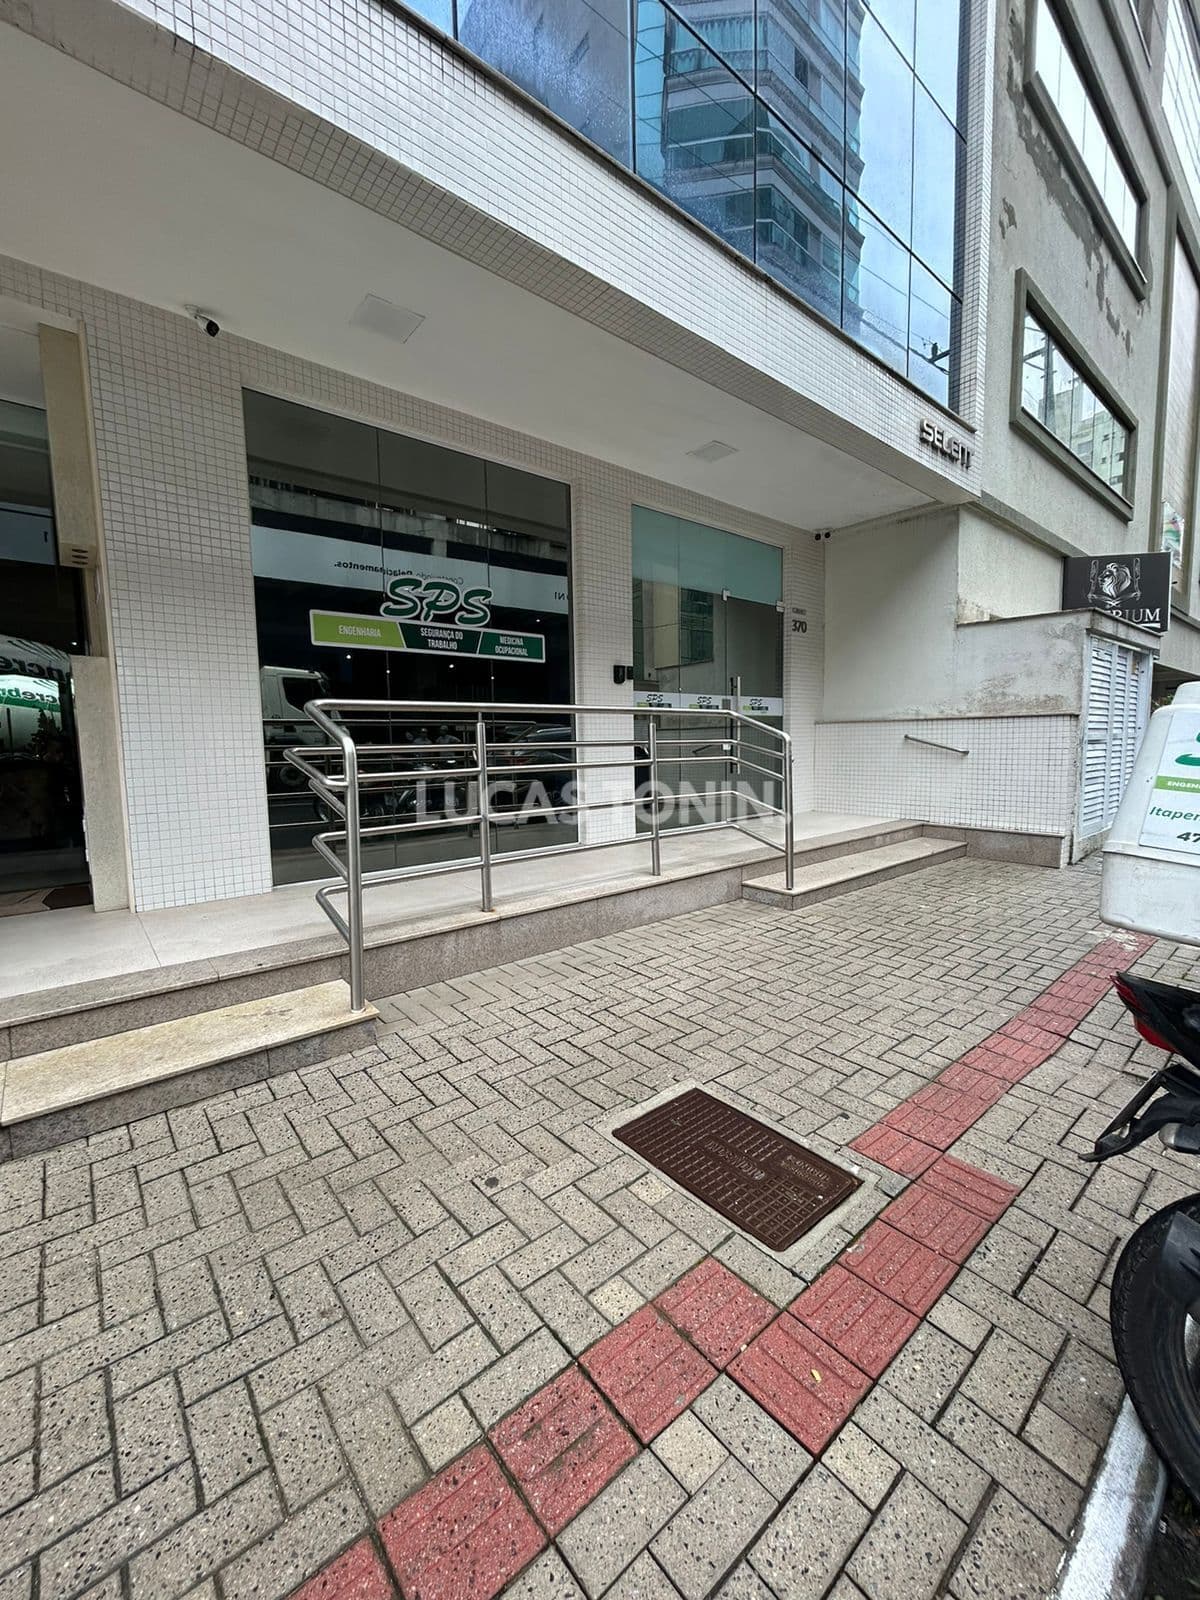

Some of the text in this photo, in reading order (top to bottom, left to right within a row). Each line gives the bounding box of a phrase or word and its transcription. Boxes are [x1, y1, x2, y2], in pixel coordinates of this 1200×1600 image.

[380, 577, 493, 626] SPS
[338, 625, 382, 637] ENGENHARIA
[791, 619, 807, 633] 370
[420, 627, 464, 640] SEGURANÇA DO
[427, 639, 458, 650] TRABALHO
[500, 636, 524, 646] MEDICINA
[494, 645, 529, 656] OCUPACIONAL
